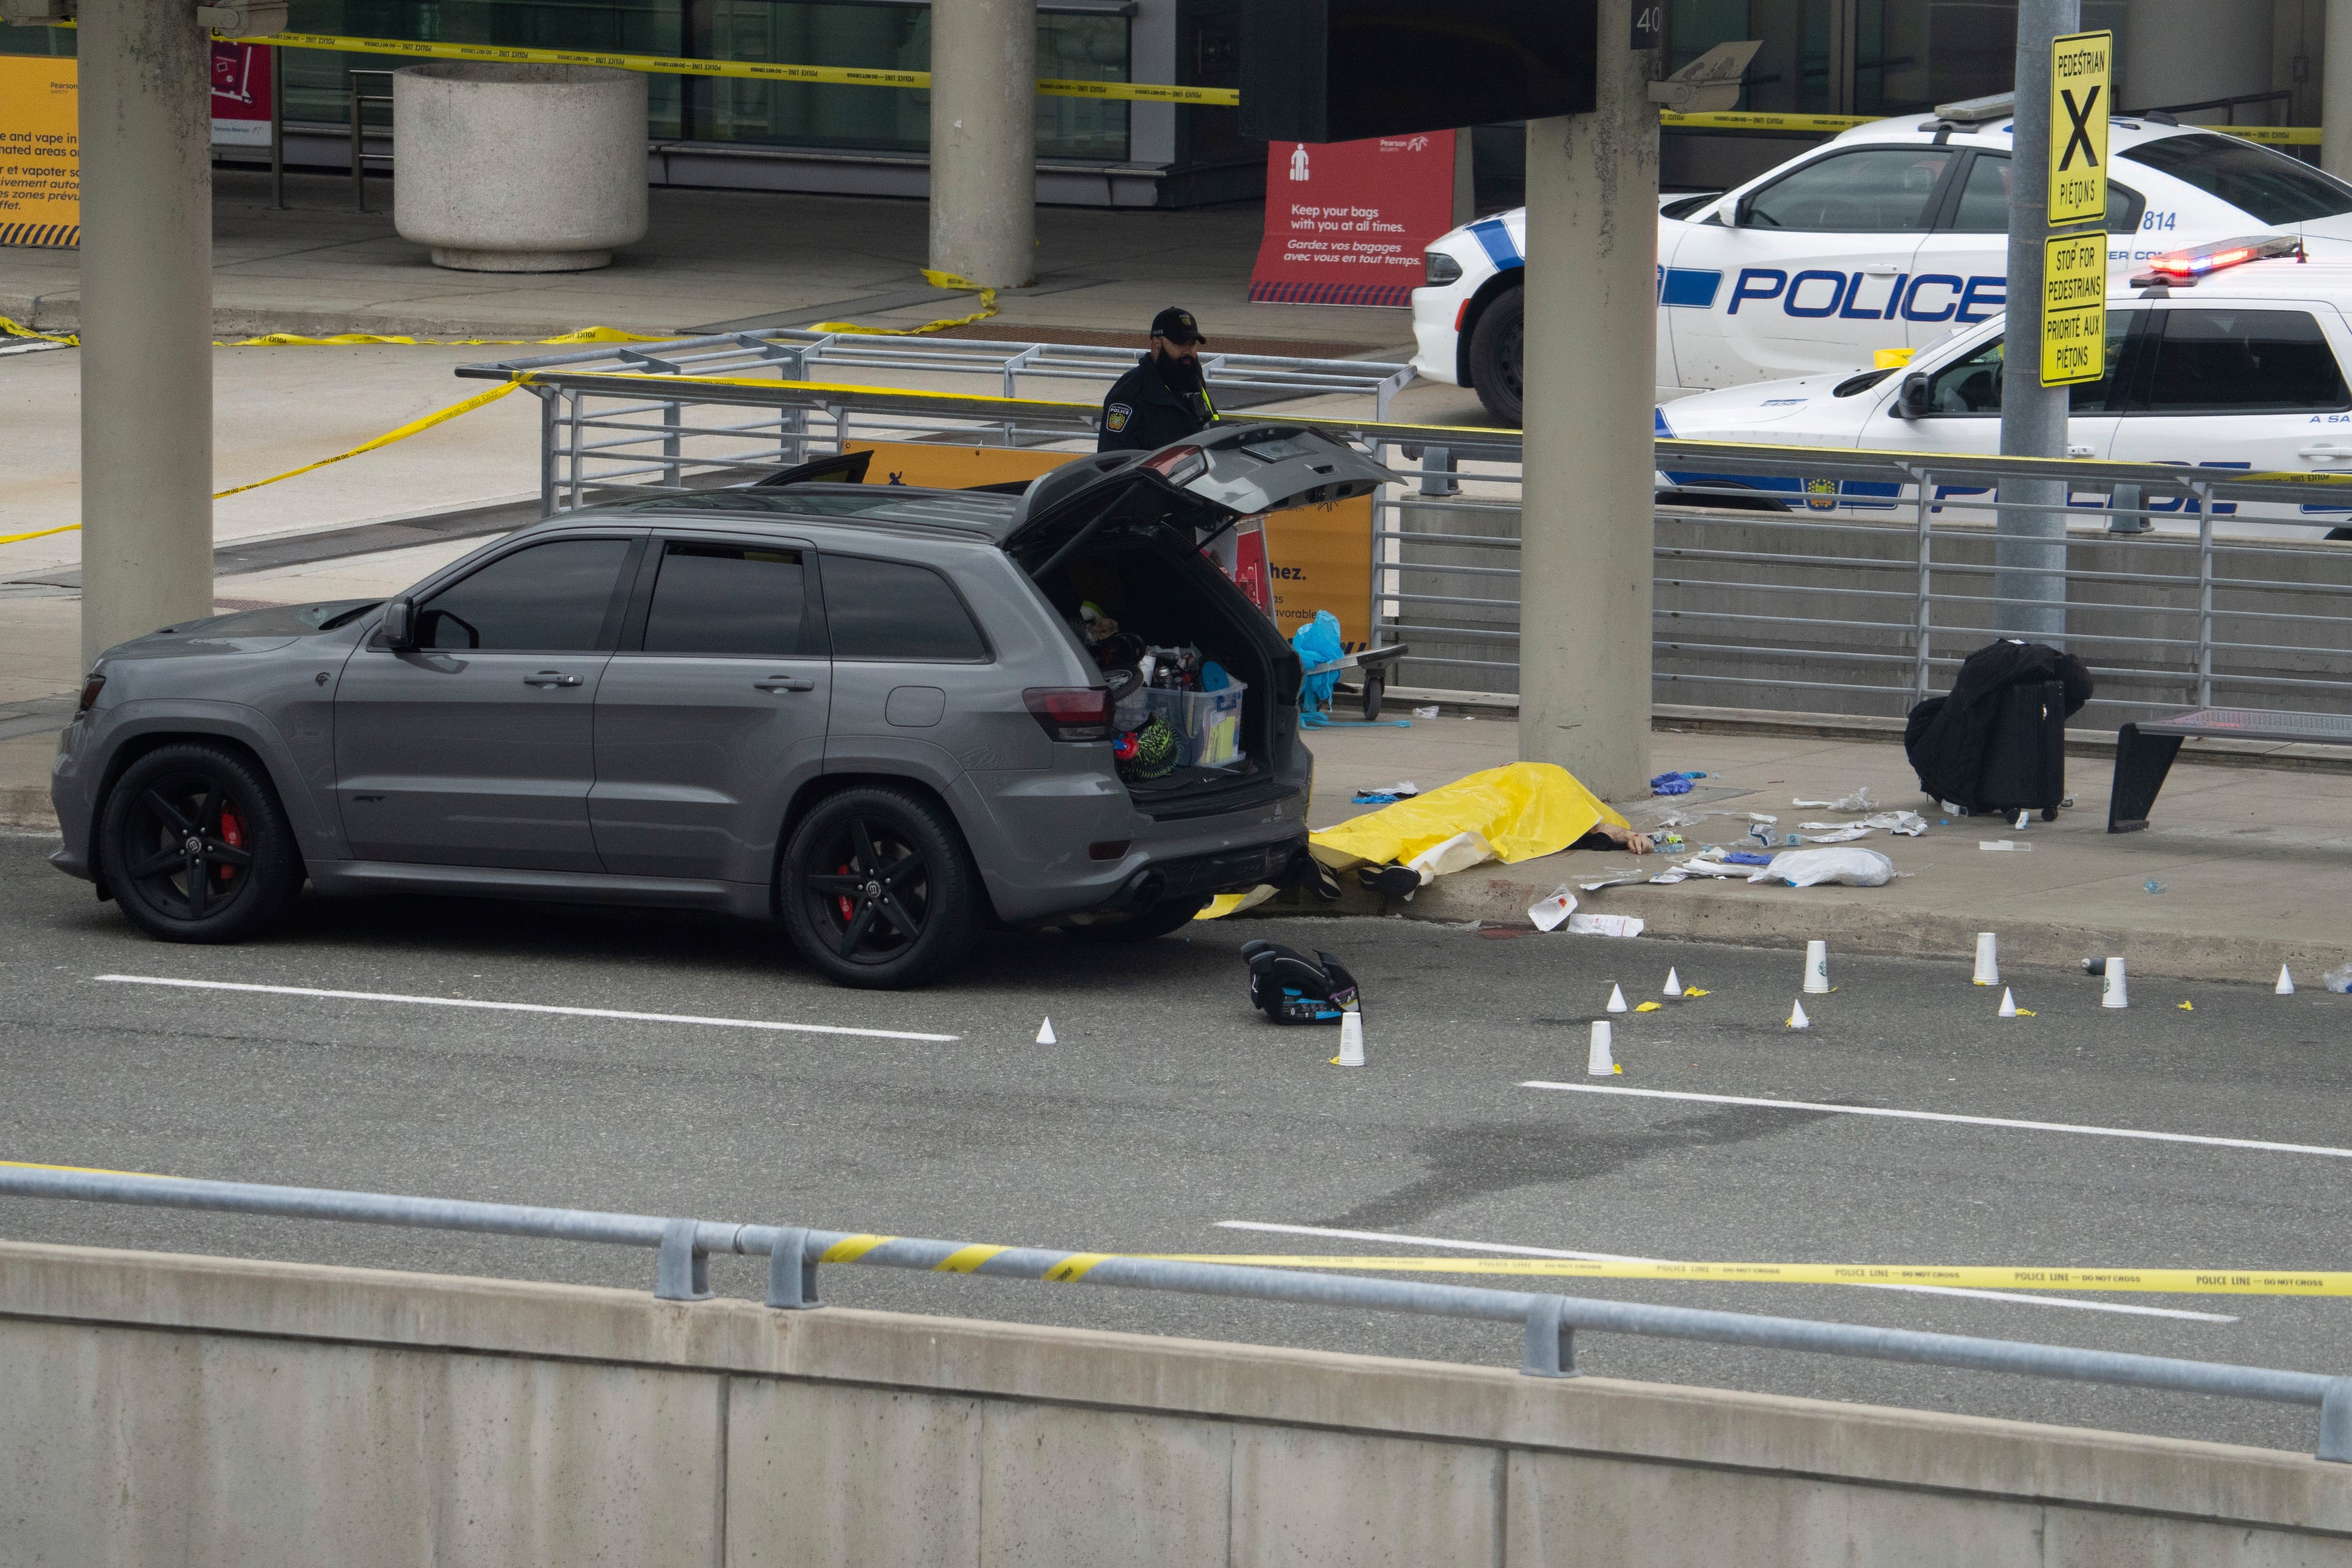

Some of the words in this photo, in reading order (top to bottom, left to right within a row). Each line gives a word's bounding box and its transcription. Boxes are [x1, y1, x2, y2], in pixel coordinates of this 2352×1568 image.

[1636, 6, 1660, 33] 40
[2058, 50, 2105, 77] PEDESTRIAN
[2058, 85, 2102, 171] X
[9, 132, 31, 142] and
[35, 134, 63, 146] vape
[67, 133, 77, 144] in
[34, 148, 66, 157] areas
[7, 166, 18, 174] et
[22, 168, 66, 178] vapoter
[12, 192, 45, 200] zones
[2060, 179, 2095, 205] PIÉTONS
[1292, 204, 1319, 216] Keep
[1323, 207, 1348, 218] your
[1351, 206, 1379, 220] bags
[1291, 219, 1314, 229] with
[1318, 222, 1338, 232] you
[1341, 221, 1353, 231] at
[1356, 221, 1369, 231] all
[1372, 221, 1405, 232] times.
[2143, 211, 2176, 231] 814
[1287, 240, 1328, 250] Gardez
[1353, 242, 1401, 254] bagages
[1284, 253, 1311, 261] avec
[1359, 253, 1382, 263] tout
[1385, 255, 1421, 267] temps.
[2056, 249, 2076, 271] STOP
[2079, 247, 2094, 268] FOR
[1727, 268, 2007, 323] POLICE
[2048, 275, 2101, 301] PEDESTRIANS
[2047, 314, 2080, 341] PRIORITÉ
[2083, 315, 2100, 336] AUX
[2057, 345, 2088, 369] PIÉTONS
[468, 399, 480, 408] LINE
[426, 415, 443, 427] CROSS
[2196, 1276, 2226, 1285] POLICE
[2231, 1276, 2250, 1285] LINE
